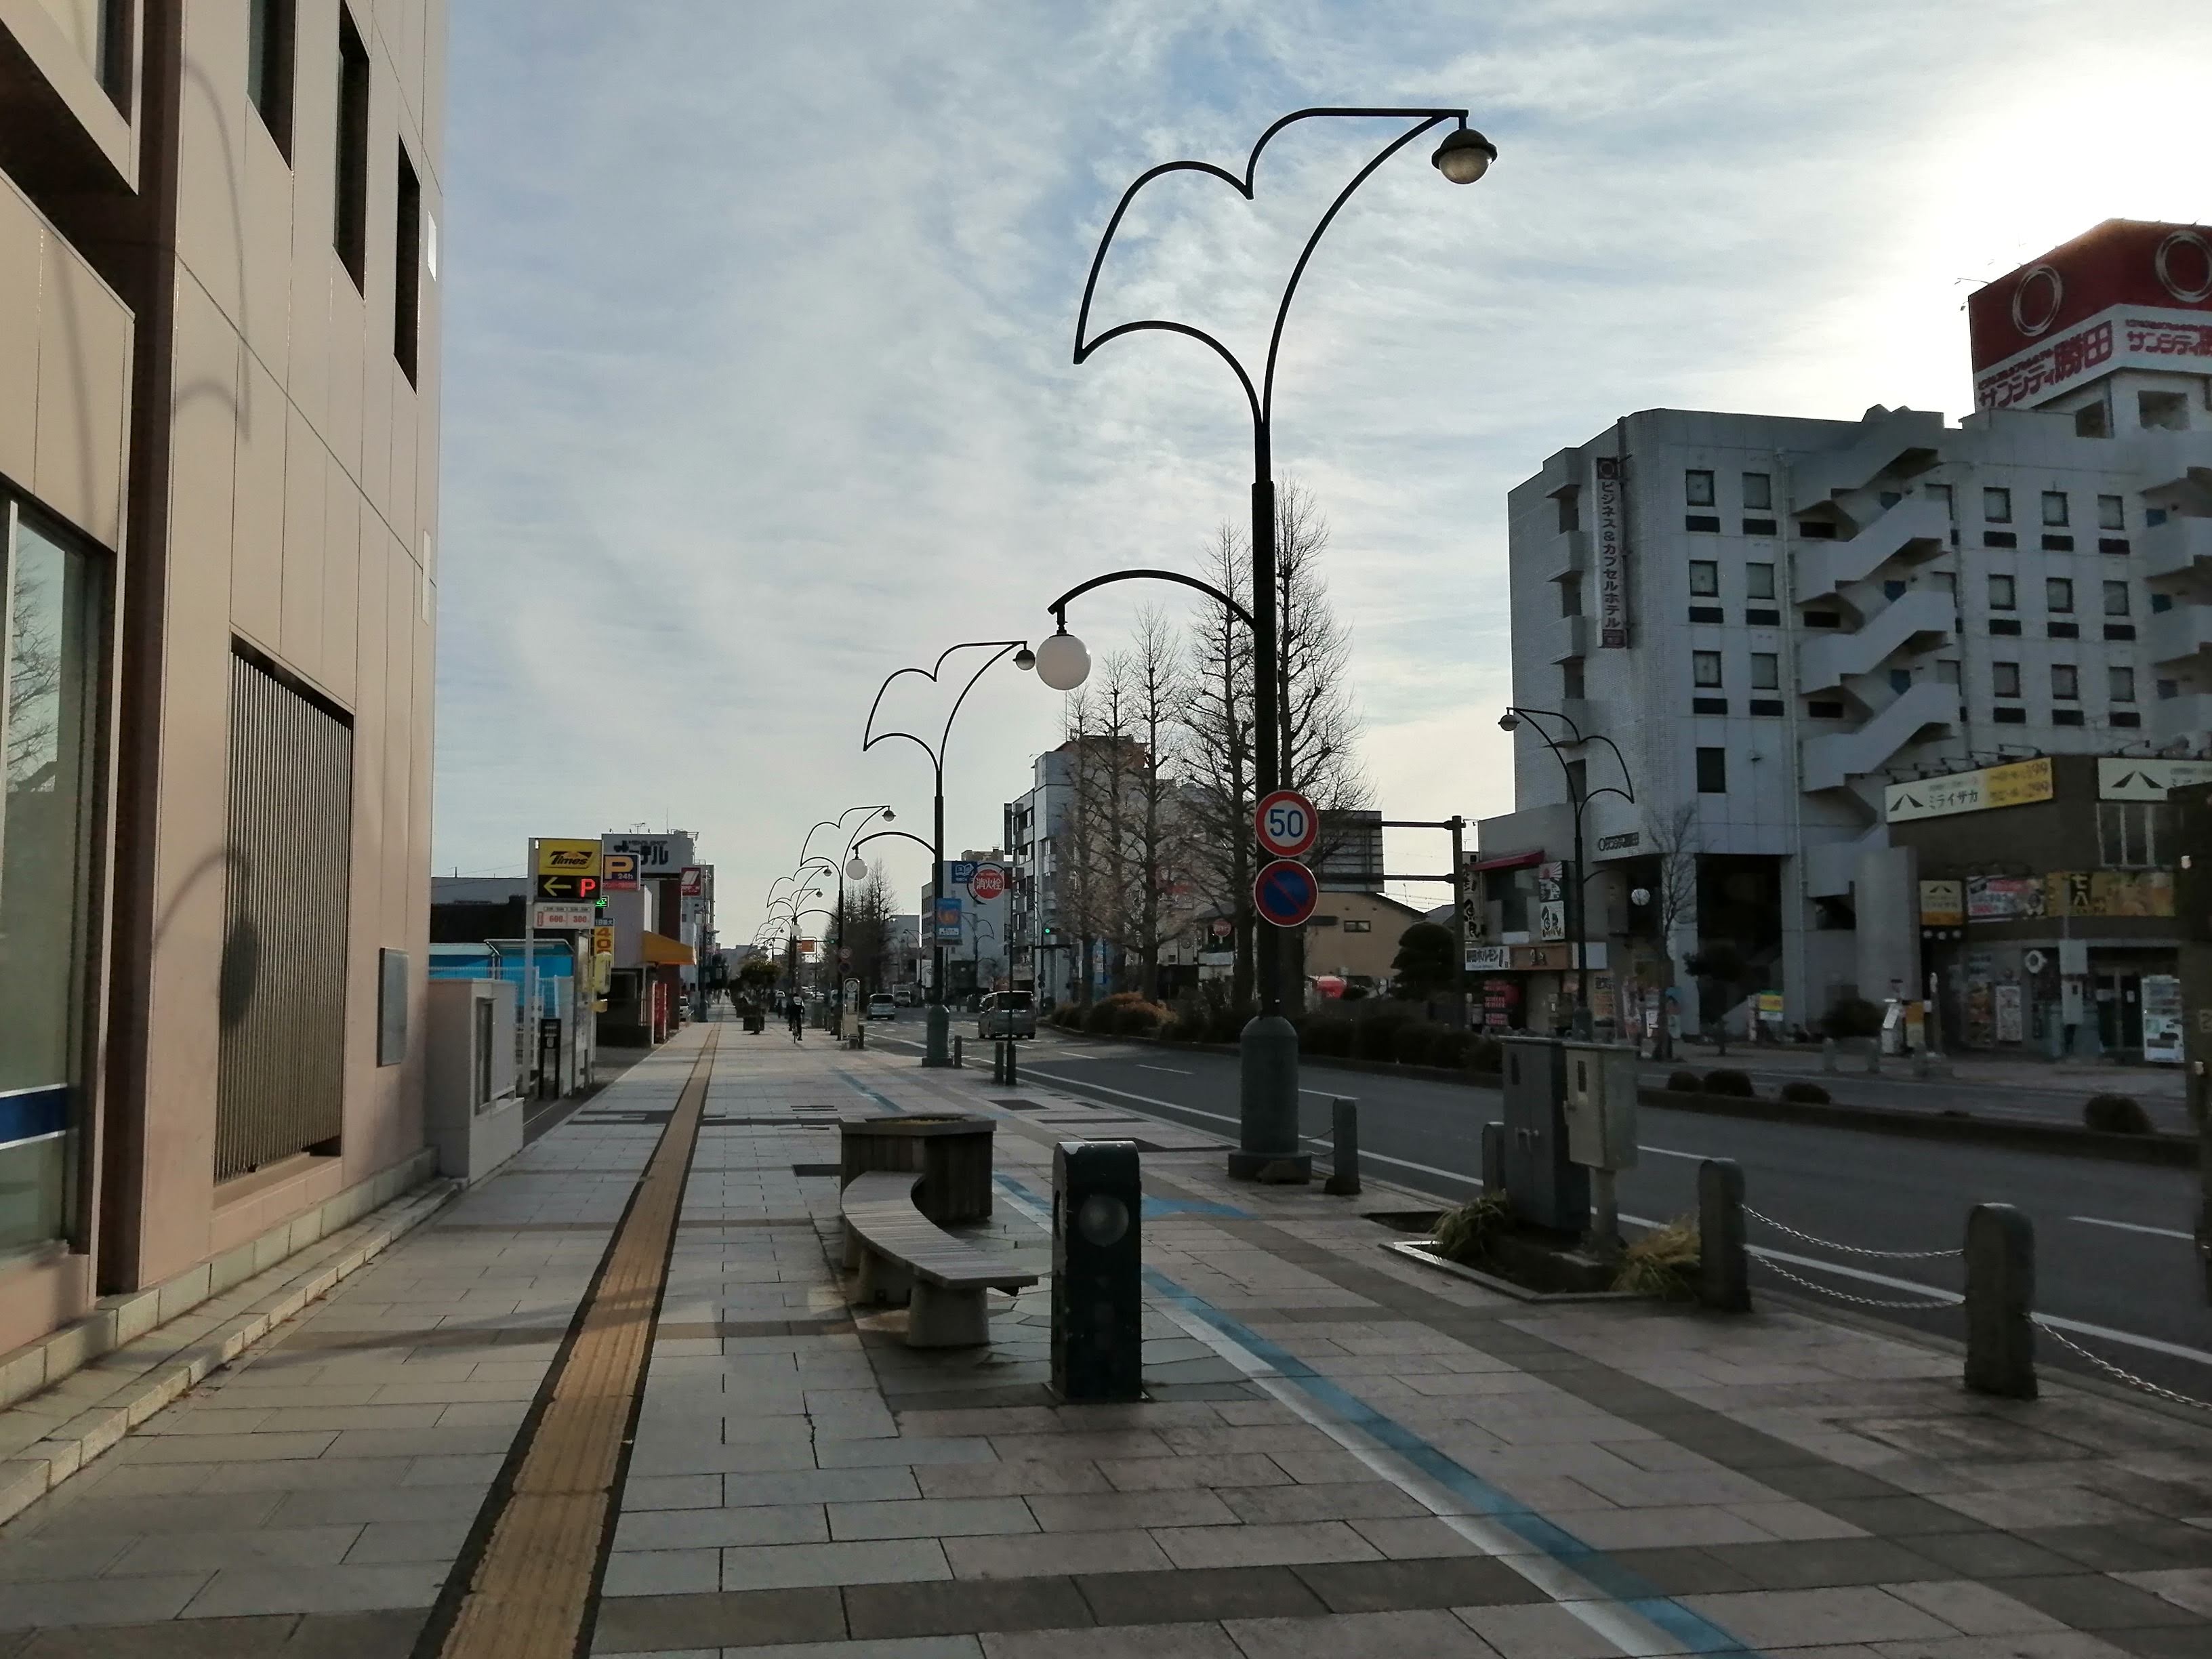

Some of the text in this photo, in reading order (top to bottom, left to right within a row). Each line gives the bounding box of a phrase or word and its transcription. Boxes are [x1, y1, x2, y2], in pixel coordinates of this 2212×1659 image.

[1269, 808, 1304, 838] 50
[549, 851, 593, 866] Times
[604, 856, 635, 880] P
[580, 878, 596, 898] P
[976, 878, 1002, 890] 消火栓
[549, 915, 563, 923] 600
